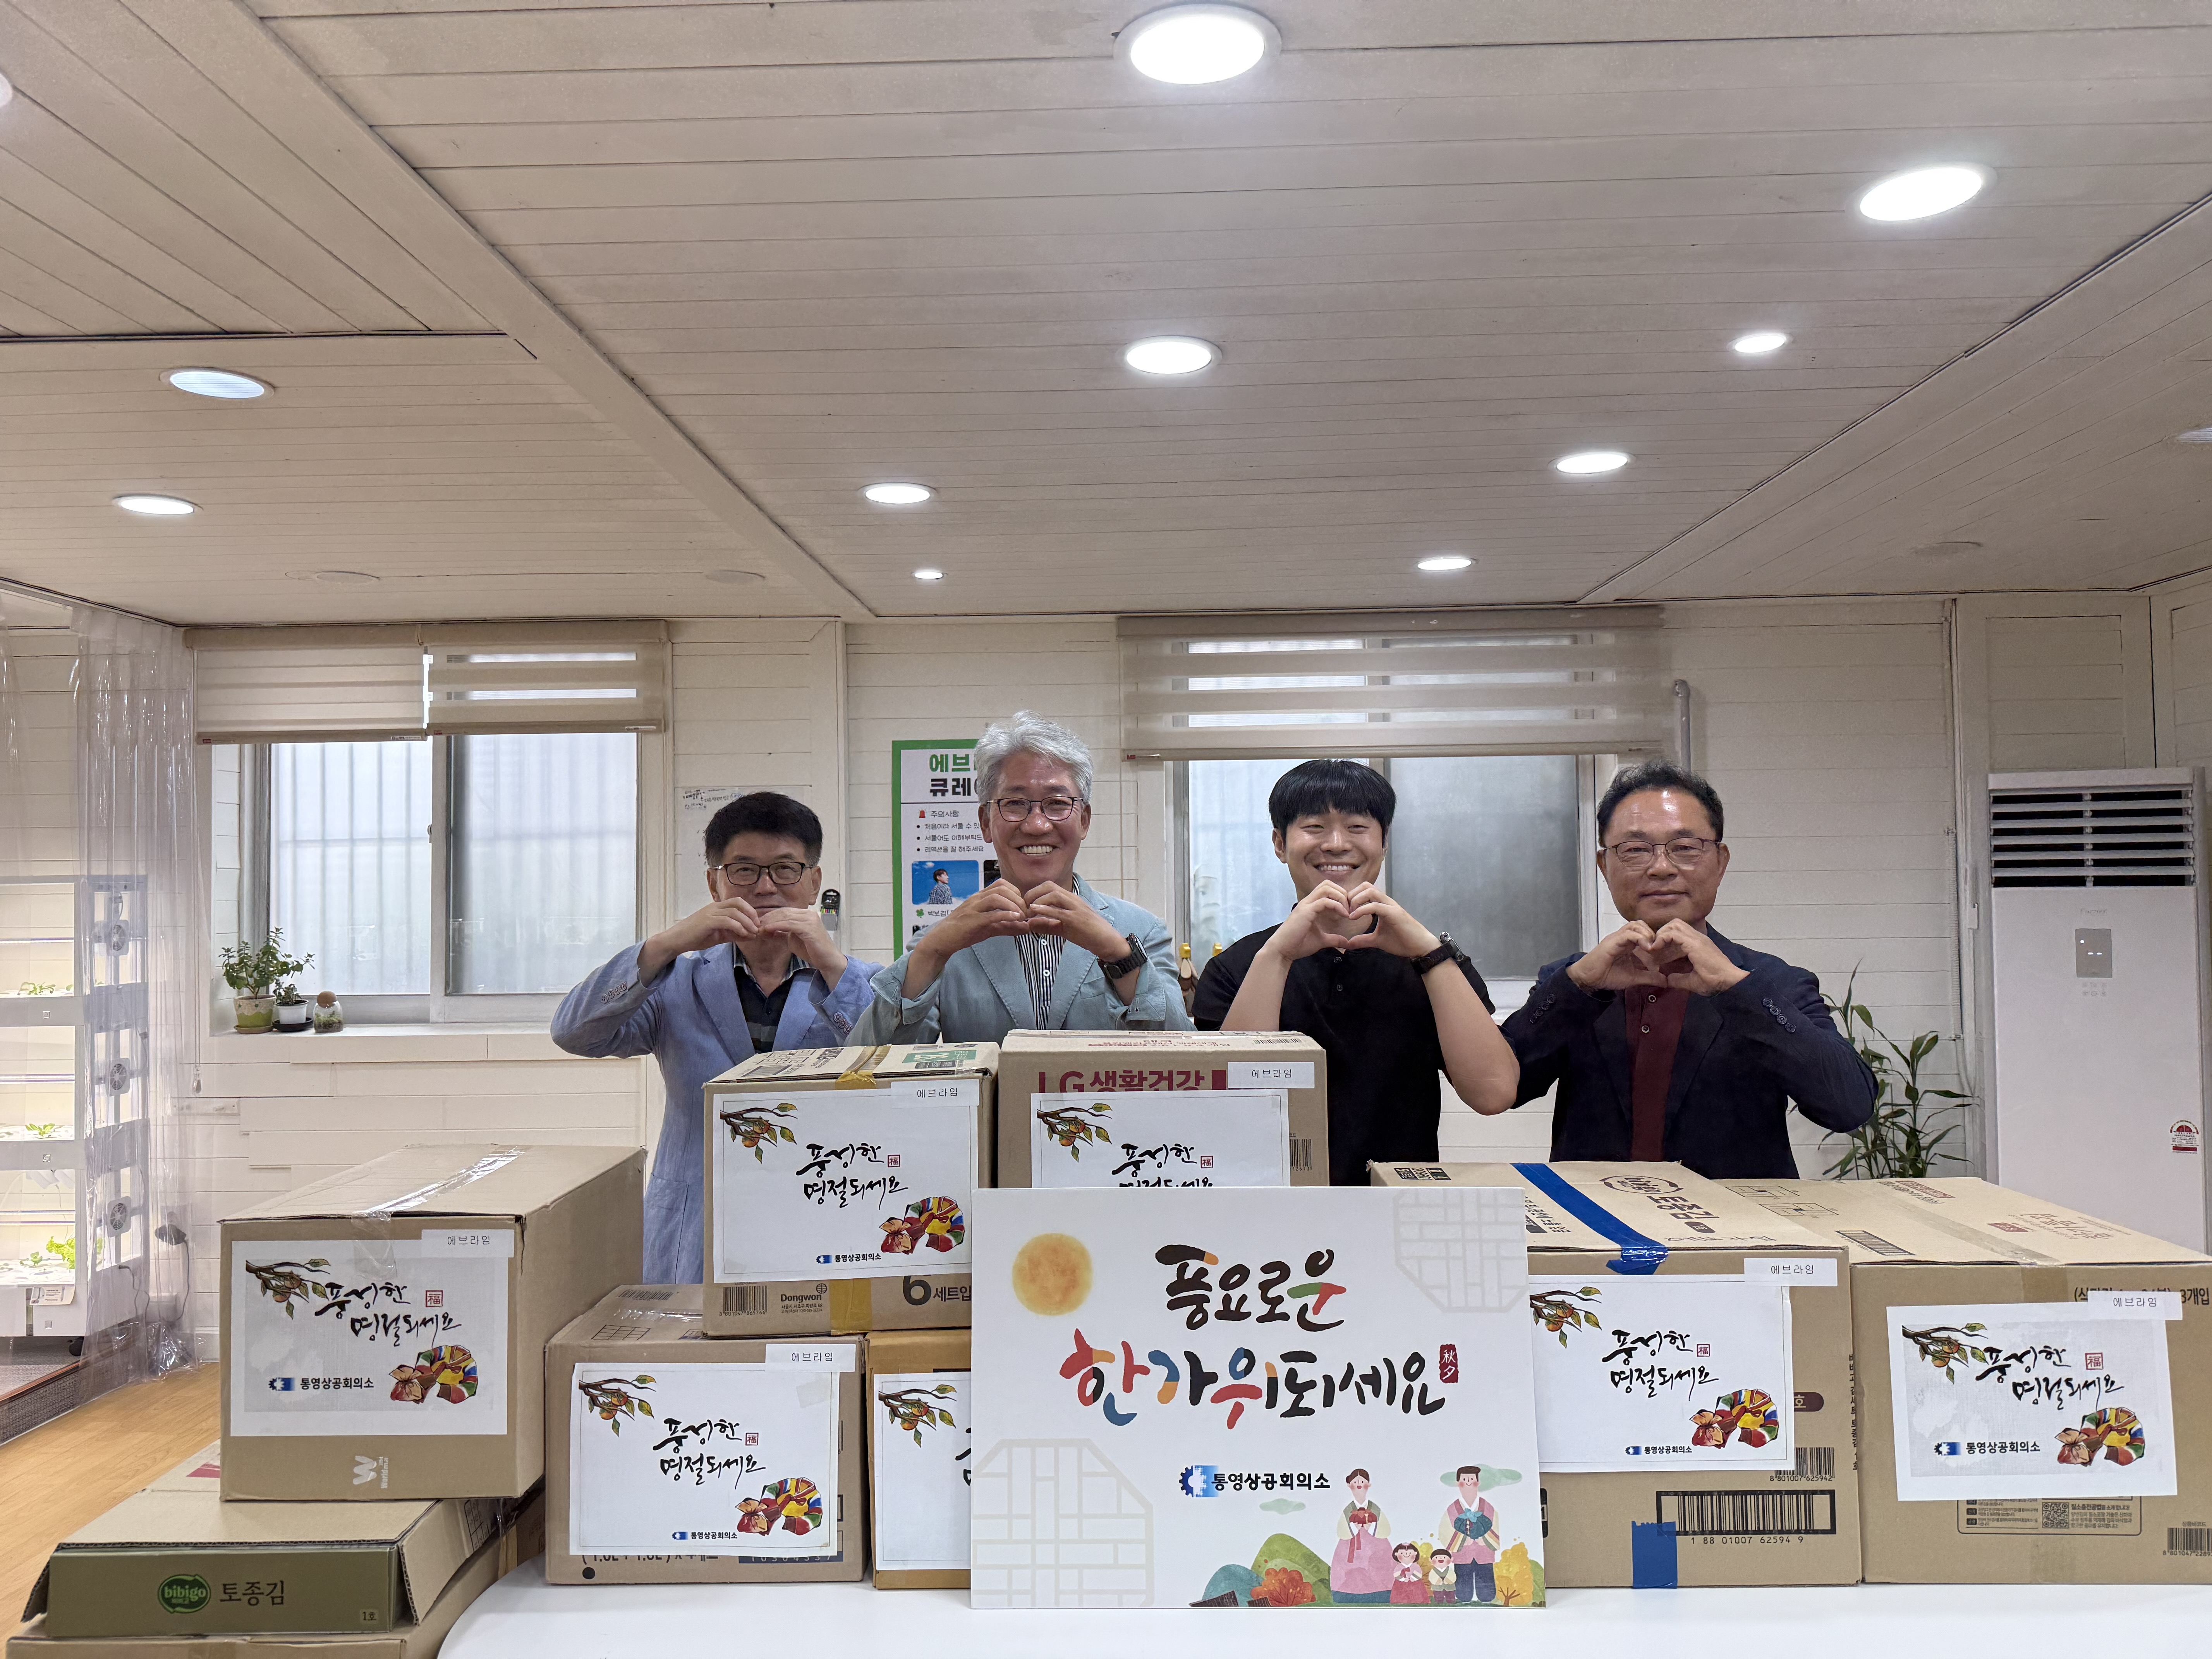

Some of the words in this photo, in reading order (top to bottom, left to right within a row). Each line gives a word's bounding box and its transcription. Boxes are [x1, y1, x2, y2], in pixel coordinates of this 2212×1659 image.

[929, 754, 977, 773] 에브
[929, 778, 979, 797] 큐레
[1252, 1069, 1291, 1078] 에브라임
[917, 1088, 957, 1097] 에브라임
[796, 1142, 884, 1177] 풍성한
[889, 1155, 900, 1167] 福
[1111, 1143, 1198, 1178] 풍성한
[1201, 1156, 1213, 1168] 福
[804, 1175, 908, 1211] 명절되세요
[1646, 1196, 1719, 1219] 토종김
[448, 1235, 489, 1245] 에브라임
[835, 1253, 881, 1262] 통영상공회의소
[1771, 1265, 1813, 1274] 에브라임
[1155, 1243, 1347, 1332] 풍요로운
[315, 1282, 411, 1319] 풍성한
[426, 1291, 443, 1307] 福
[781, 1294, 822, 1303] Dongwon
[2113, 1298, 2156, 1307] 에브라임
[350, 1312, 462, 1348] 명절되세요
[1602, 1329, 1693, 1365] 풍성한
[1698, 1345, 1710, 1357] 福
[792, 1353, 832, 1362] 에브라임
[1441, 1349, 1456, 1380] 秋夕
[1975, 1345, 2071, 1384] 풍성한
[2086, 1353, 2103, 1370] 福
[301, 1377, 374, 1389] 통영상공회의소
[1059, 1327, 1446, 1430] 한가위되세요
[1610, 1365, 1719, 1401] 명절되세요
[2013, 1374, 2125, 1410] 명절되세요
[653, 1418, 742, 1453] 풍성한
[746, 1433, 758, 1445] 福
[1644, 1446, 1692, 1454] 통영상공회의소
[1966, 1441, 2040, 1454] 통영상공회의소
[660, 1453, 766, 1490] 명절되세요
[1211, 1473, 1330, 1491] 통영상공회의소
[690, 1531, 738, 1540] 통영상공회의소
[165, 1585, 206, 1602] bibigo
[220, 1580, 284, 1606] 토종김
[362, 1612, 377, 1621] 1호
